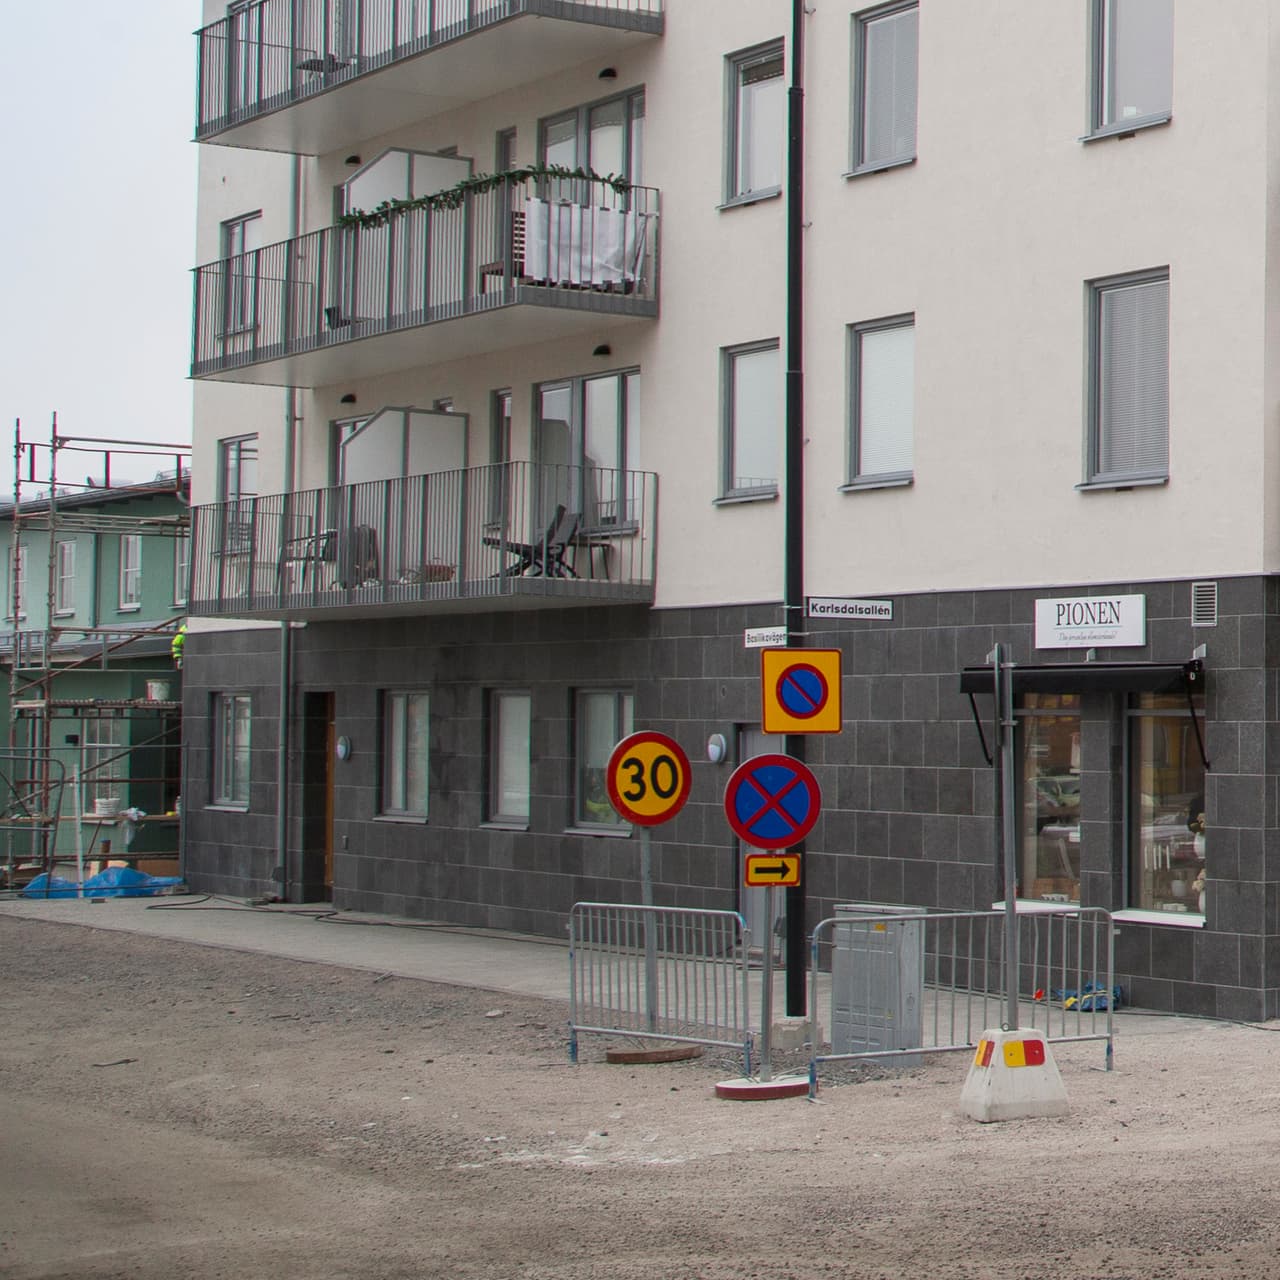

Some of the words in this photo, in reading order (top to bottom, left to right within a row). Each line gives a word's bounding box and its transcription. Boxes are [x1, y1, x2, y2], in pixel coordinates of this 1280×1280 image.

[811, 603, 890, 616] Karlsdalsallén
[1056, 601, 1121, 626] PIONEN
[622, 755, 679, 802] 30
